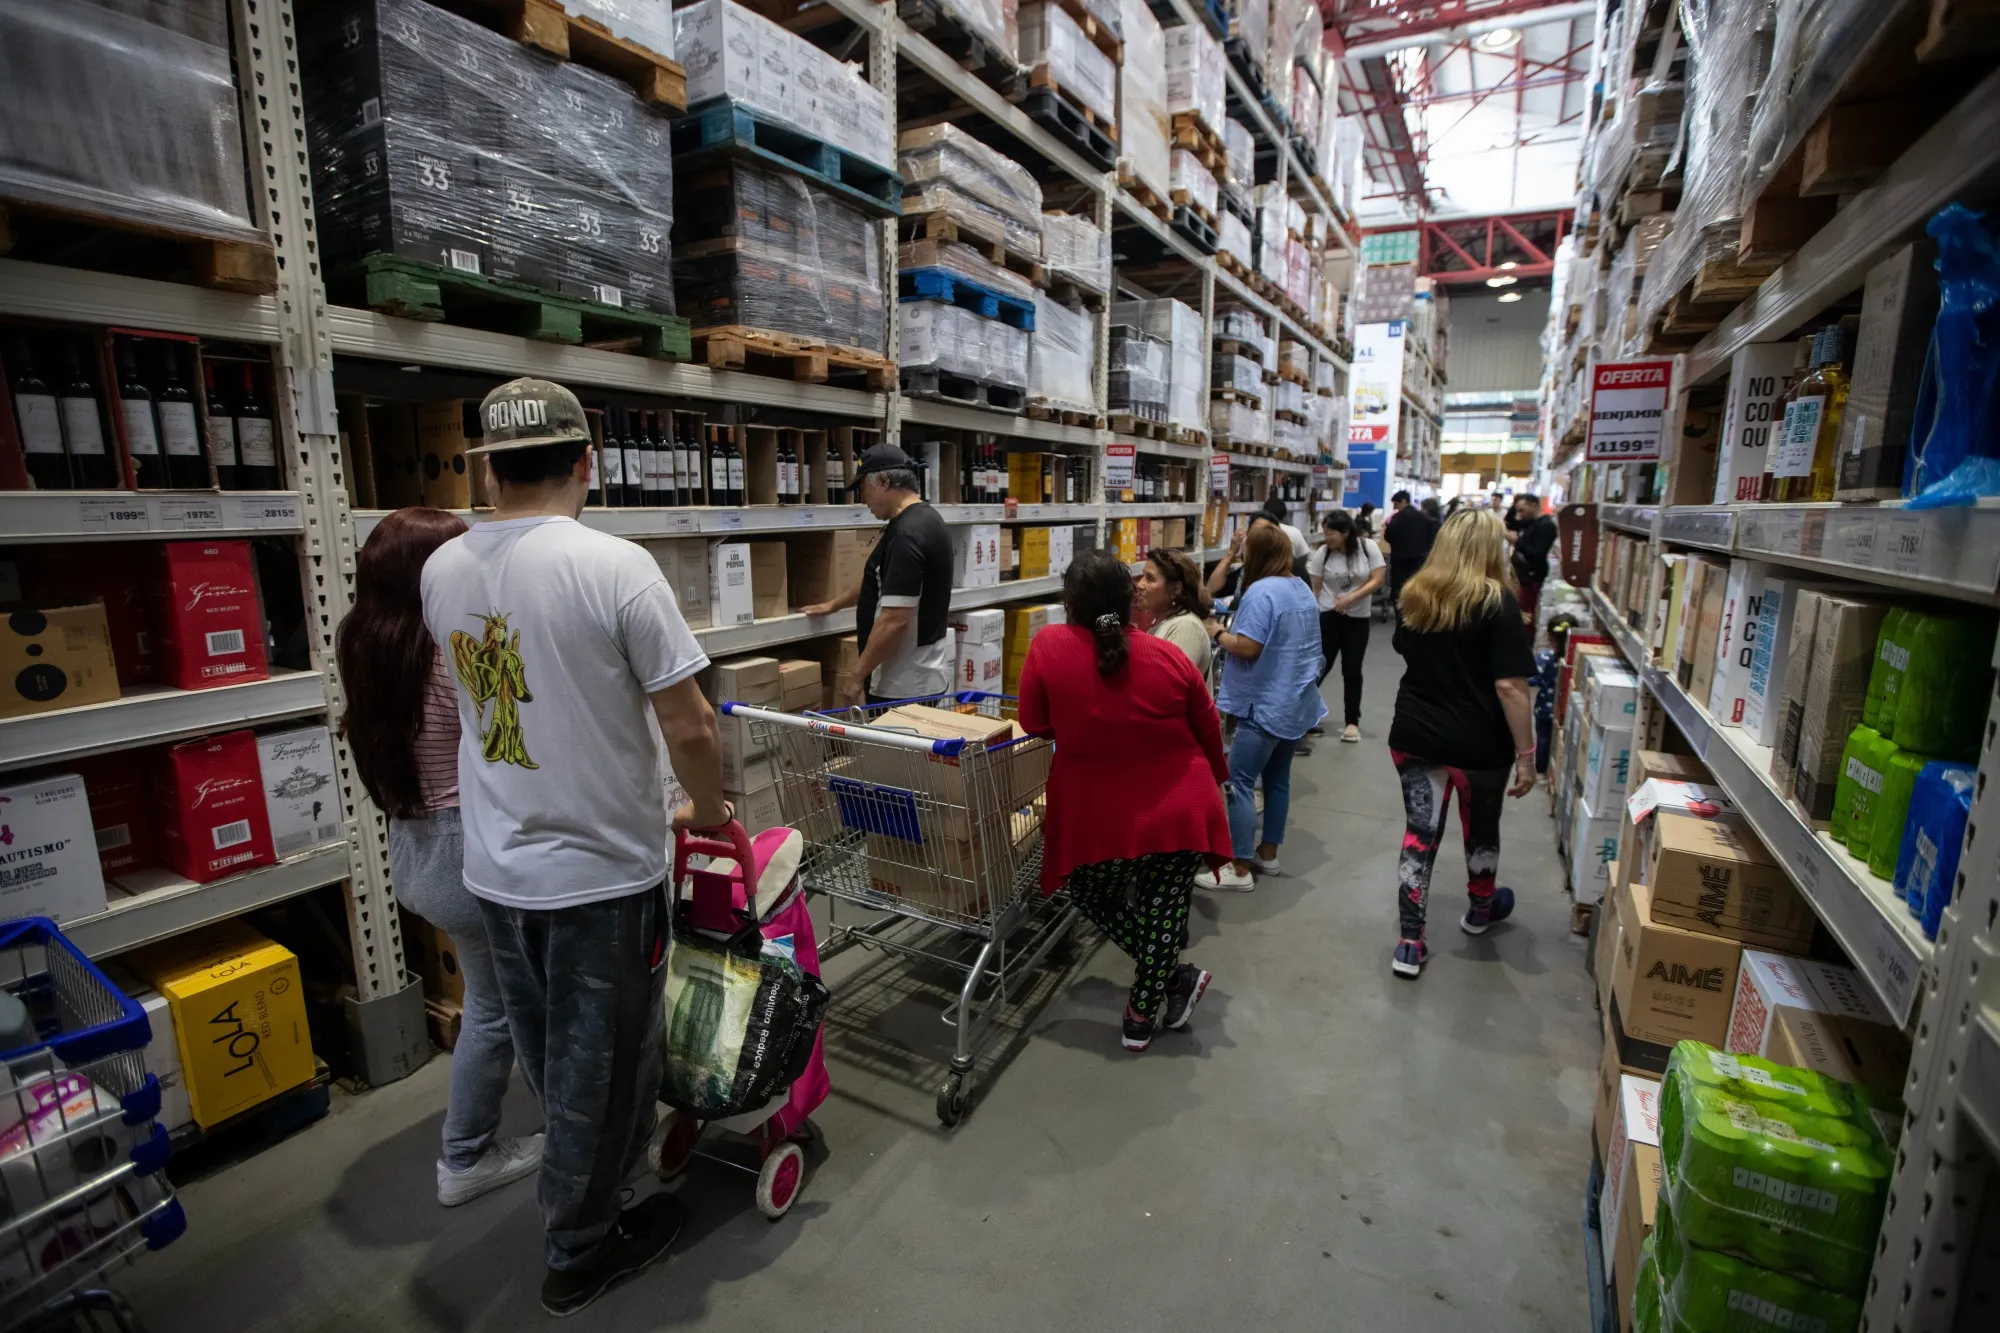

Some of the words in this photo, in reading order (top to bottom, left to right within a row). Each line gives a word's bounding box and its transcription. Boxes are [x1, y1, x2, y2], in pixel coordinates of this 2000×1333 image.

[1599, 367, 1665, 385] OFERTA
[1748, 376, 1775, 398] NO
[489, 399, 548, 432] BONDI
[1594, 409, 1662, 421] BENJAMIN
[1348, 427, 1373, 440] RTA
[1742, 427, 1767, 448] QU
[1646, 960, 1725, 993] AIMÉ
[255, 990, 270, 1020] BLEND
[764, 982, 781, 1025] Reutiliza
[208, 1000, 261, 1079] LOLA
[259, 1020, 272, 1039] RED
[753, 1028, 770, 1069] Reduce
